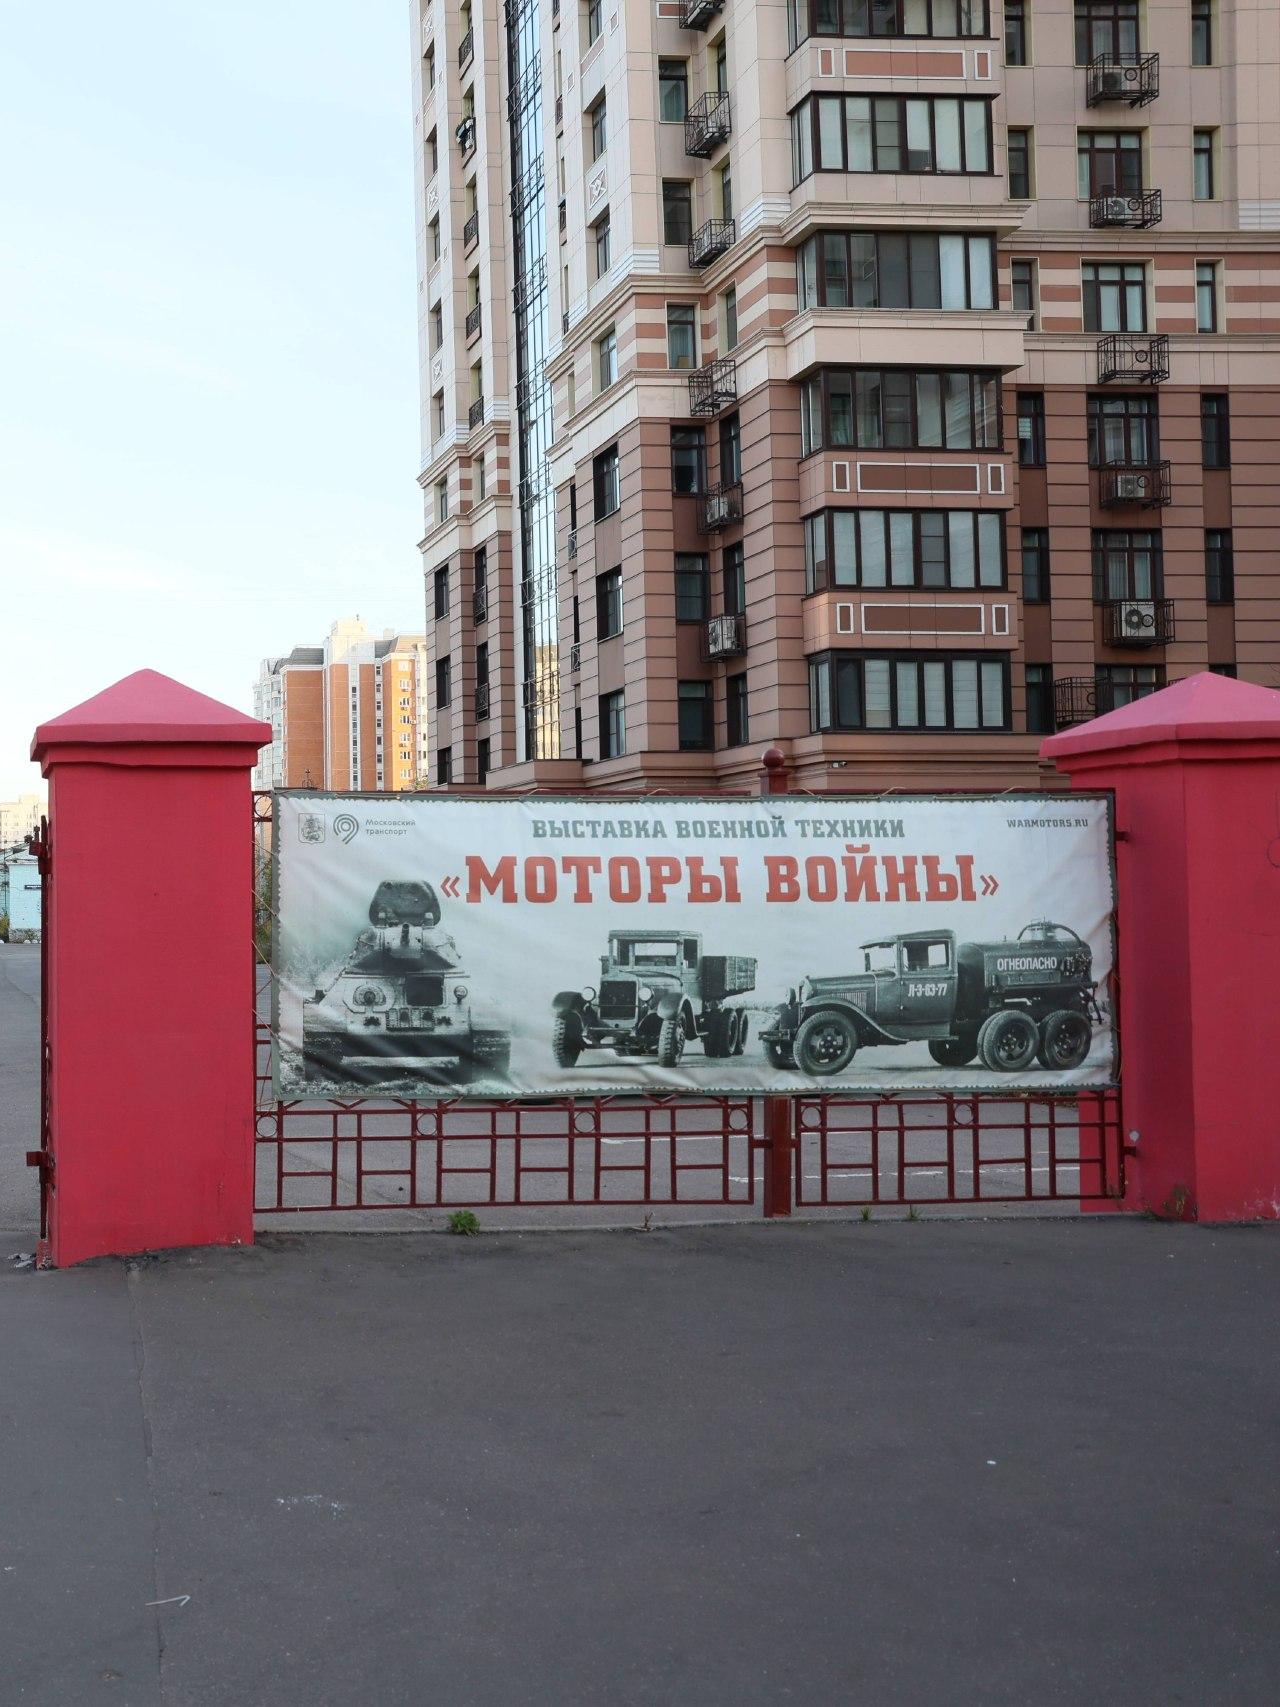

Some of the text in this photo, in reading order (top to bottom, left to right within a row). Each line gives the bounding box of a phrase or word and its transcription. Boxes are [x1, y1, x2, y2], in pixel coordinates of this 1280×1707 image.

[365, 818, 416, 827] Московский
[532, 815, 906, 839] ВЫСТАВКА ВОЕННОЙ ТЕХНИКИ
[1006, 818, 1089, 829] WARMOTORS.RU
[366, 828, 408, 837] транспорт
[440, 843, 1000, 903] «МОТОРЫ ВОЙНЫ»
[997, 956, 1058, 972] ОГНЕОПАСНО
